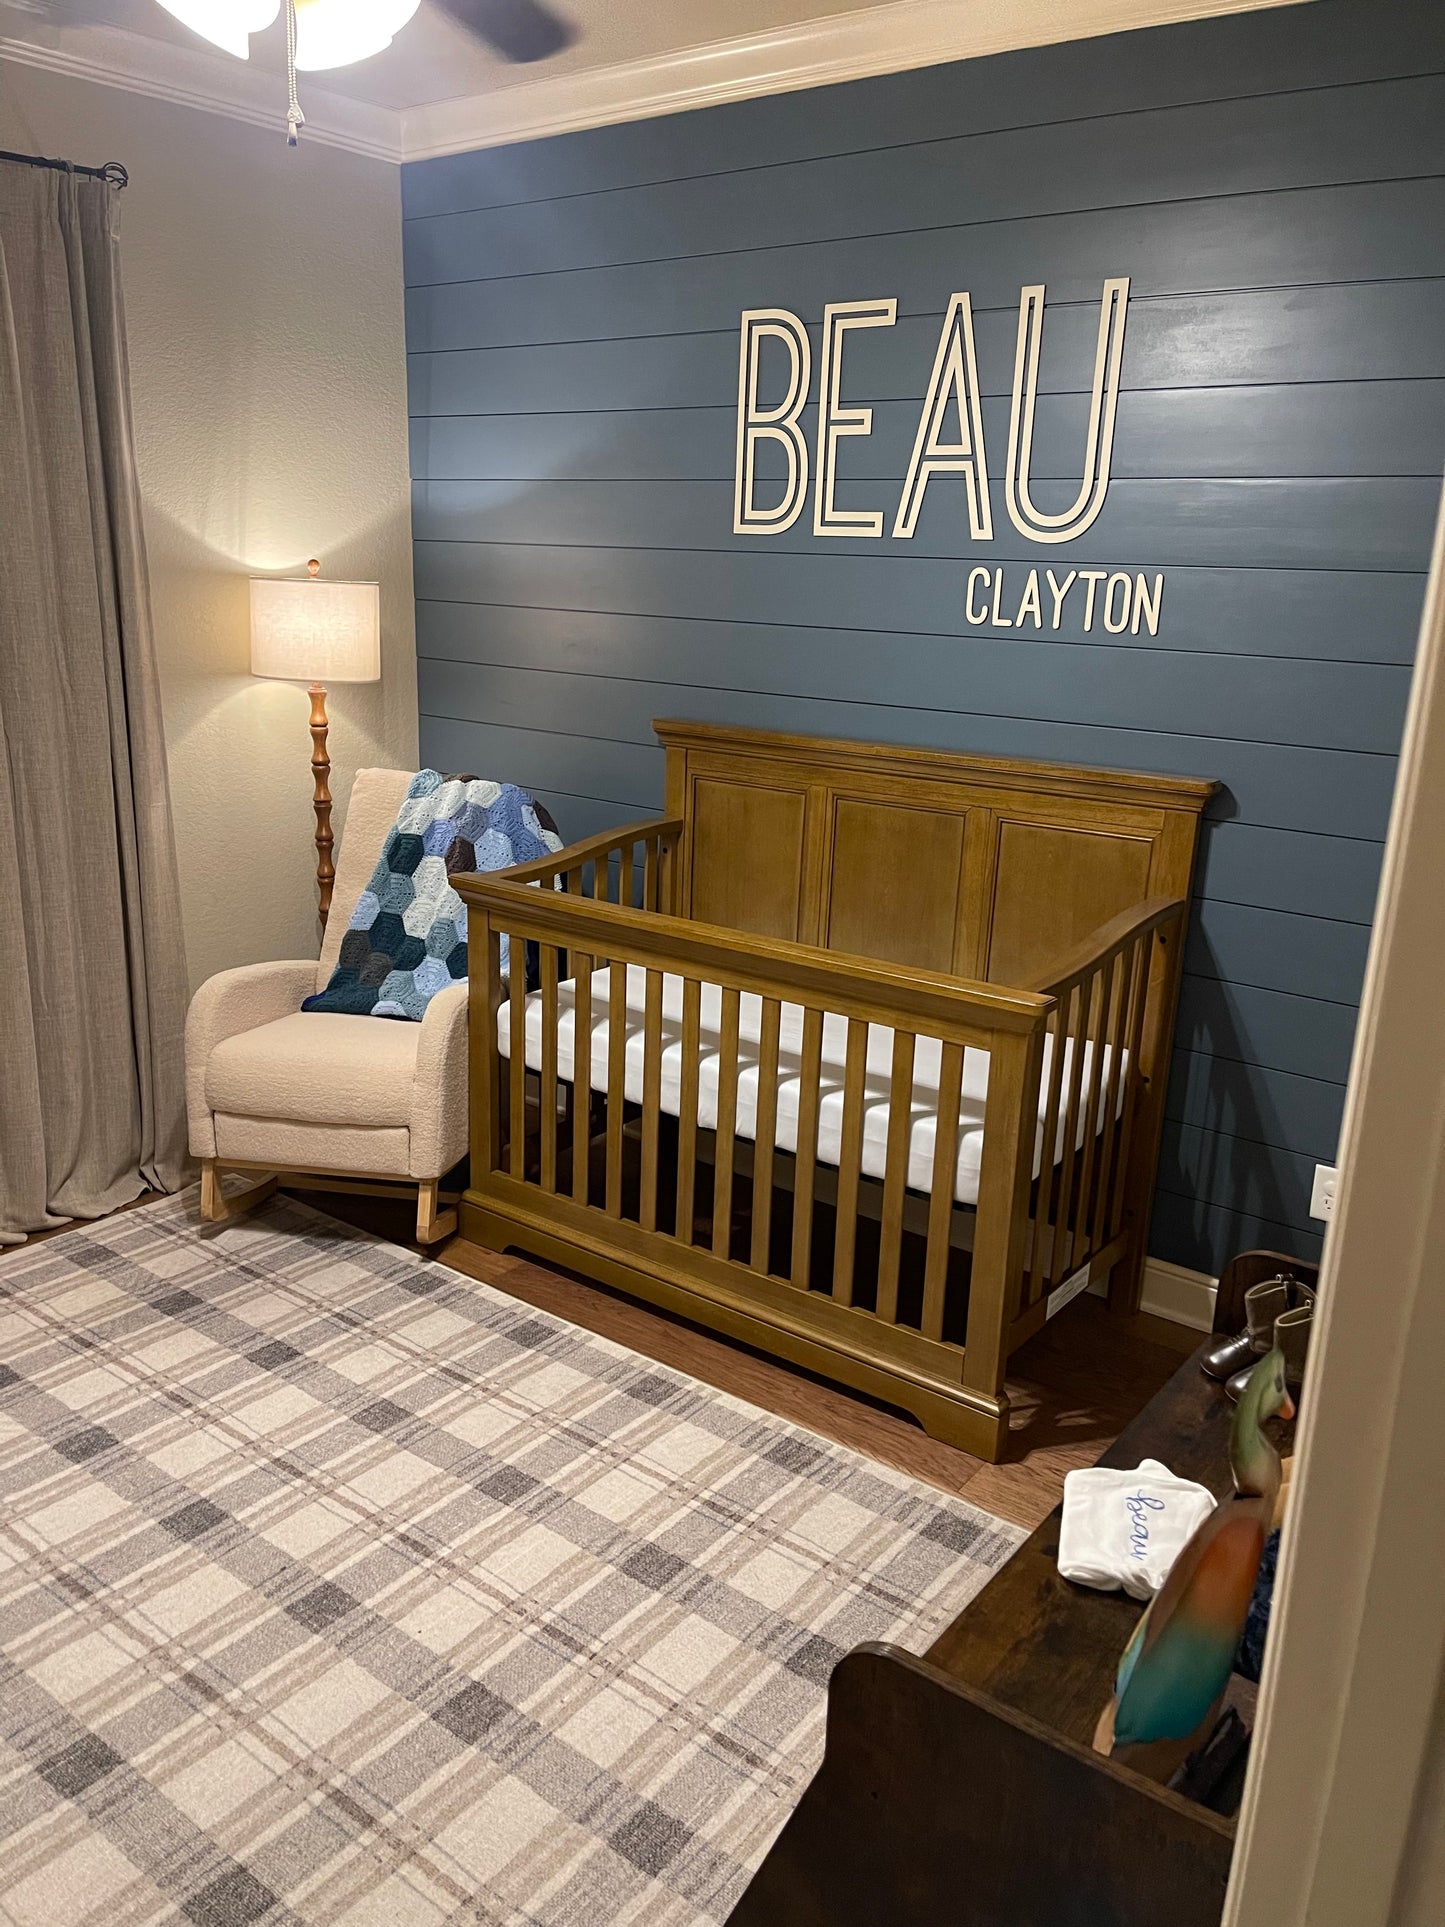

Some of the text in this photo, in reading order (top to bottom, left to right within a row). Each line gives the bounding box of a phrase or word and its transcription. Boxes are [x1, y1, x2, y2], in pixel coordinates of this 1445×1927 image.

[733, 277, 1130, 543] BEAU
[965, 566, 1164, 636] CLAYTON
[1125, 1489, 1166, 1561] beau
